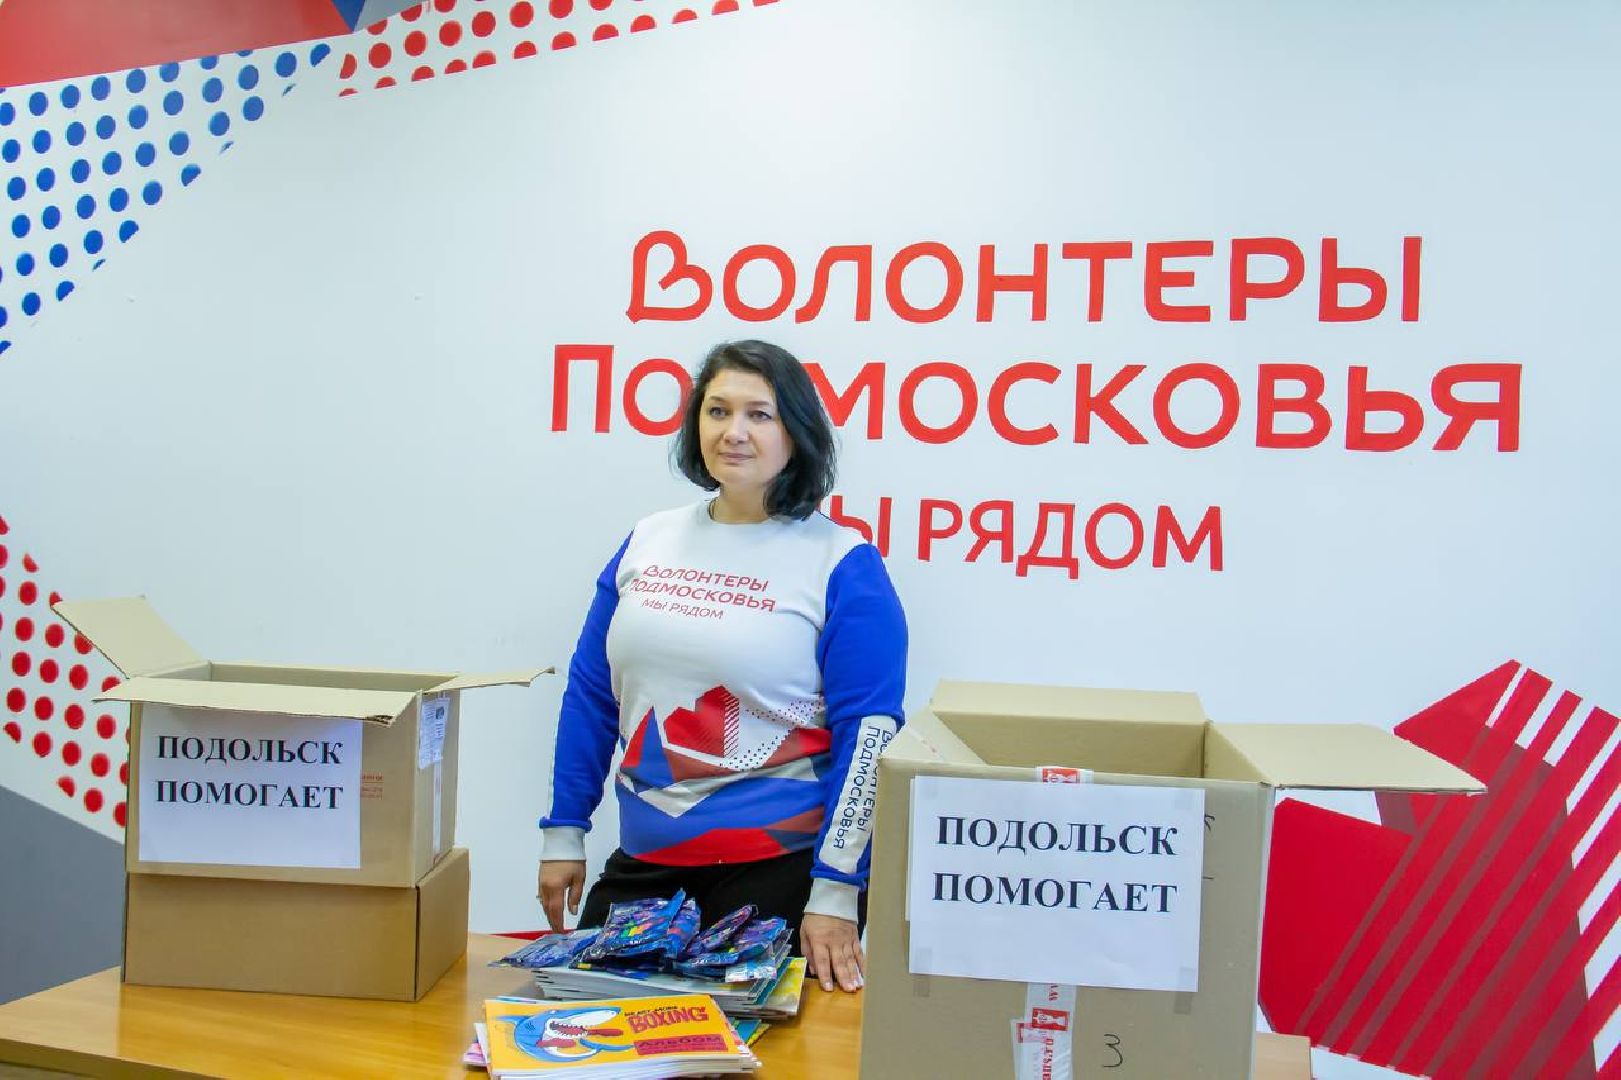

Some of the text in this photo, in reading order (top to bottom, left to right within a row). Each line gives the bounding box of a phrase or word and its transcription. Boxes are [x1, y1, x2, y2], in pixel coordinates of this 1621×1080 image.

[626, 230, 1422, 324] ВОЛОНТЕРЫ
[551, 345, 1522, 452] ПОМОСКОВЬЯ
[918, 499, 1223, 579] РЯДОМ
[643, 564, 768, 592] ВОЛОНТЕРЫ
[642, 598, 724, 620] МЫ РЯДОМ
[158, 735, 343, 765] ПОДОЛЬСК
[156, 780, 344, 809] ПОМОГАЕТ
[833, 725, 880, 849] ПОДМОСКОВЬЯ
[936, 816, 1178, 856] ПОДОЛЬСК
[933, 872, 1178, 912] ПОМОГАЕТ
[629, 1006, 709, 1033] BOXING
